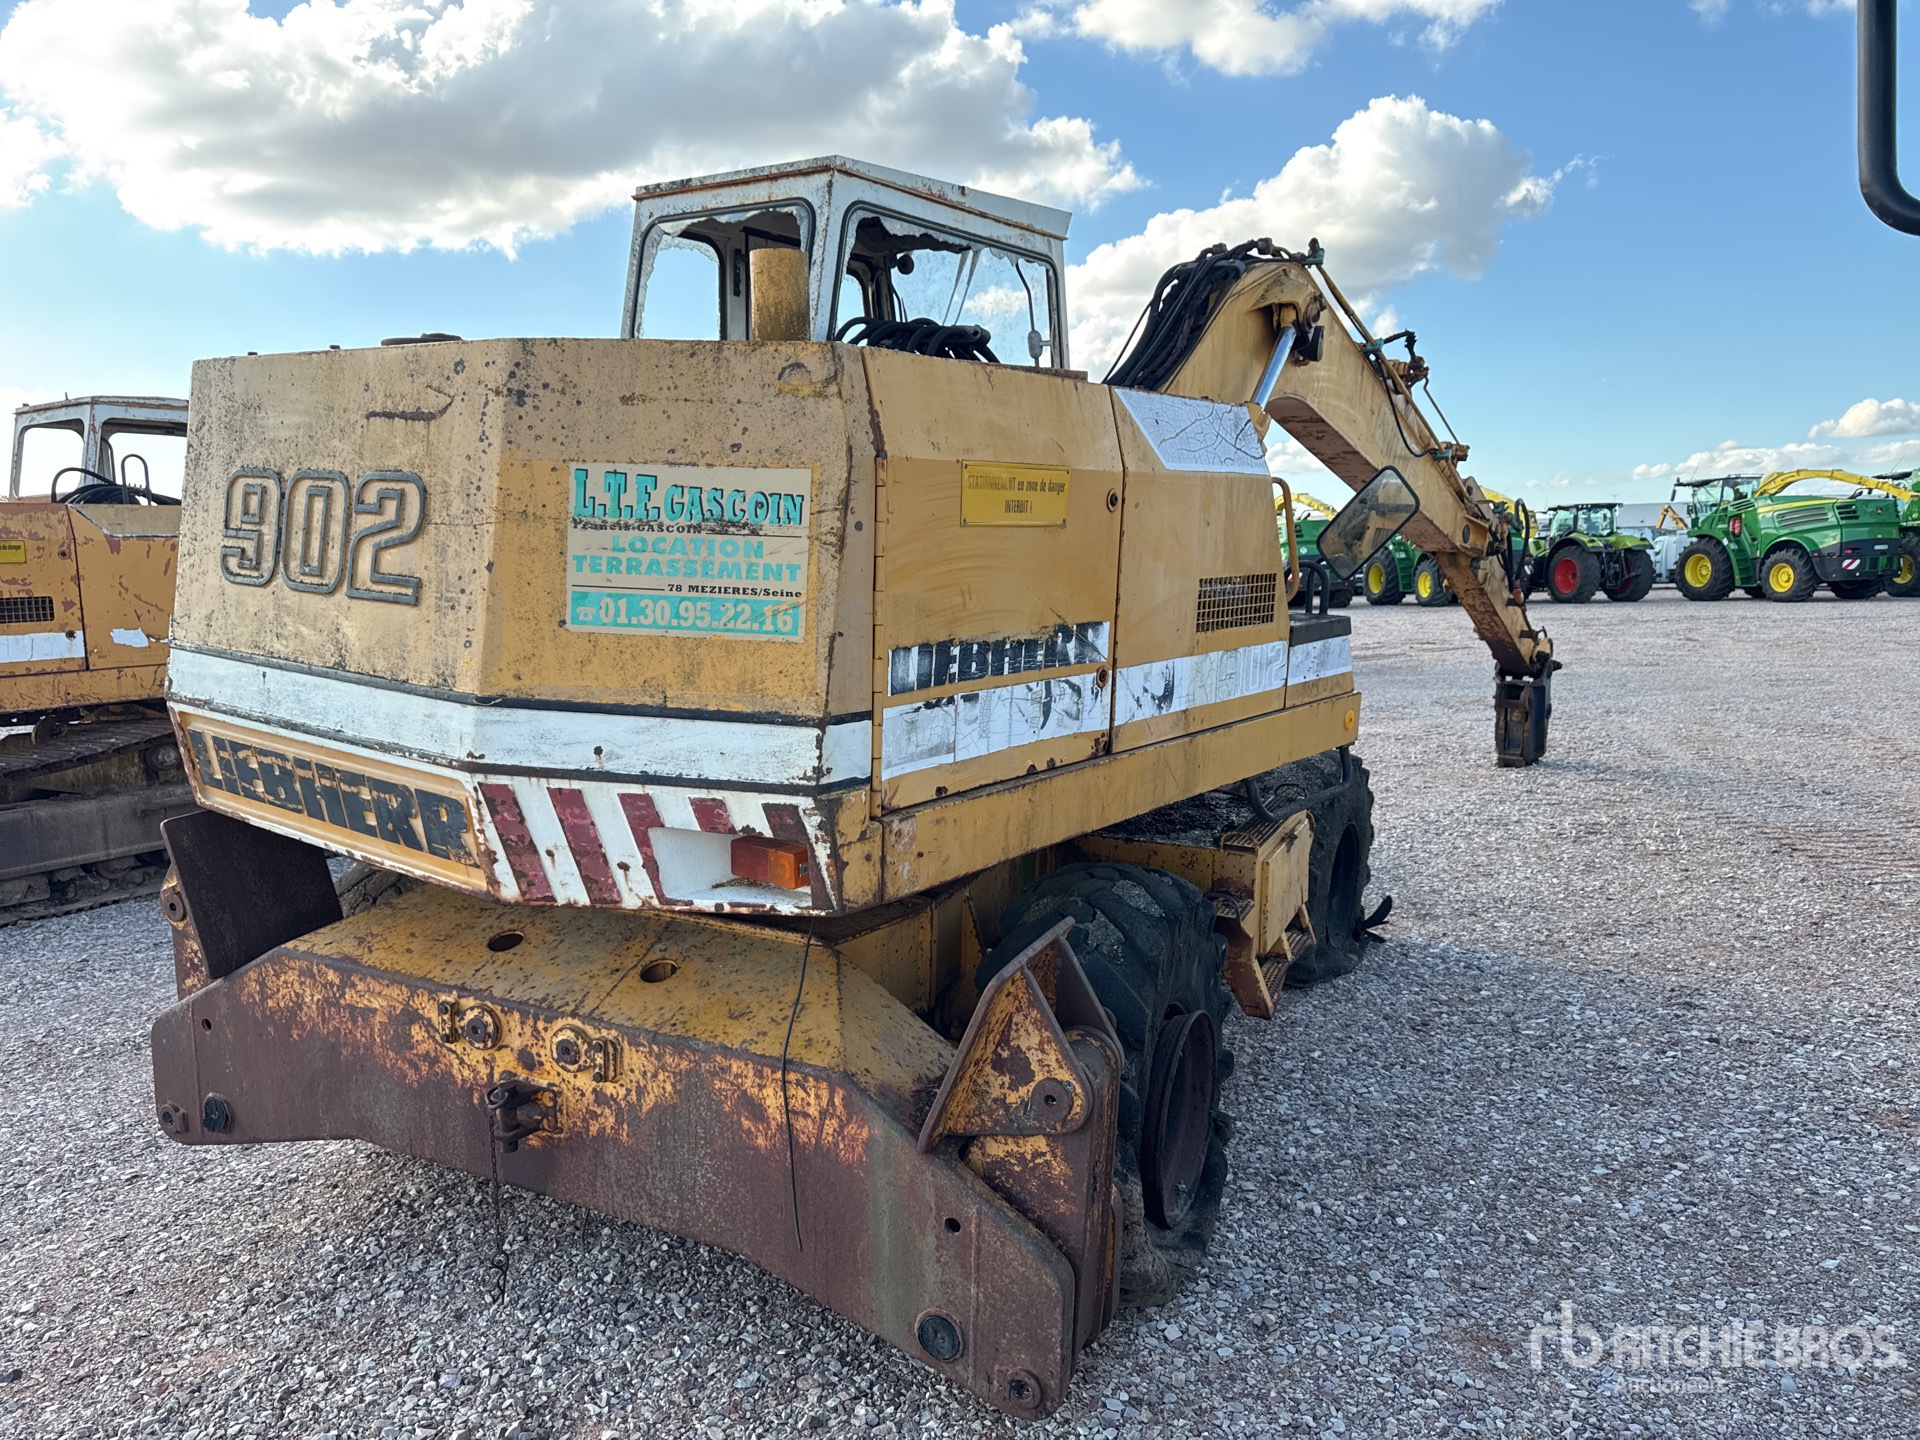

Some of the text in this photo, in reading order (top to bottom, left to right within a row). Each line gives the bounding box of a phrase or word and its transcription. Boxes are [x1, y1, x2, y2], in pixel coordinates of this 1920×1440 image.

[573, 468, 805, 526] L.T.F. GASCOIN
[967, 475, 1066, 496] STATIONNEMENT en zone de danger
[1004, 499, 1029, 514] INTERDIT
[219, 467, 427, 606] 902
[612, 535, 764, 559] LOCATION
[572, 555, 801, 582] TERRASSEMENT
[667, 583, 683, 593] 78
[601, 597, 794, 632] 01.30.95.22.16
